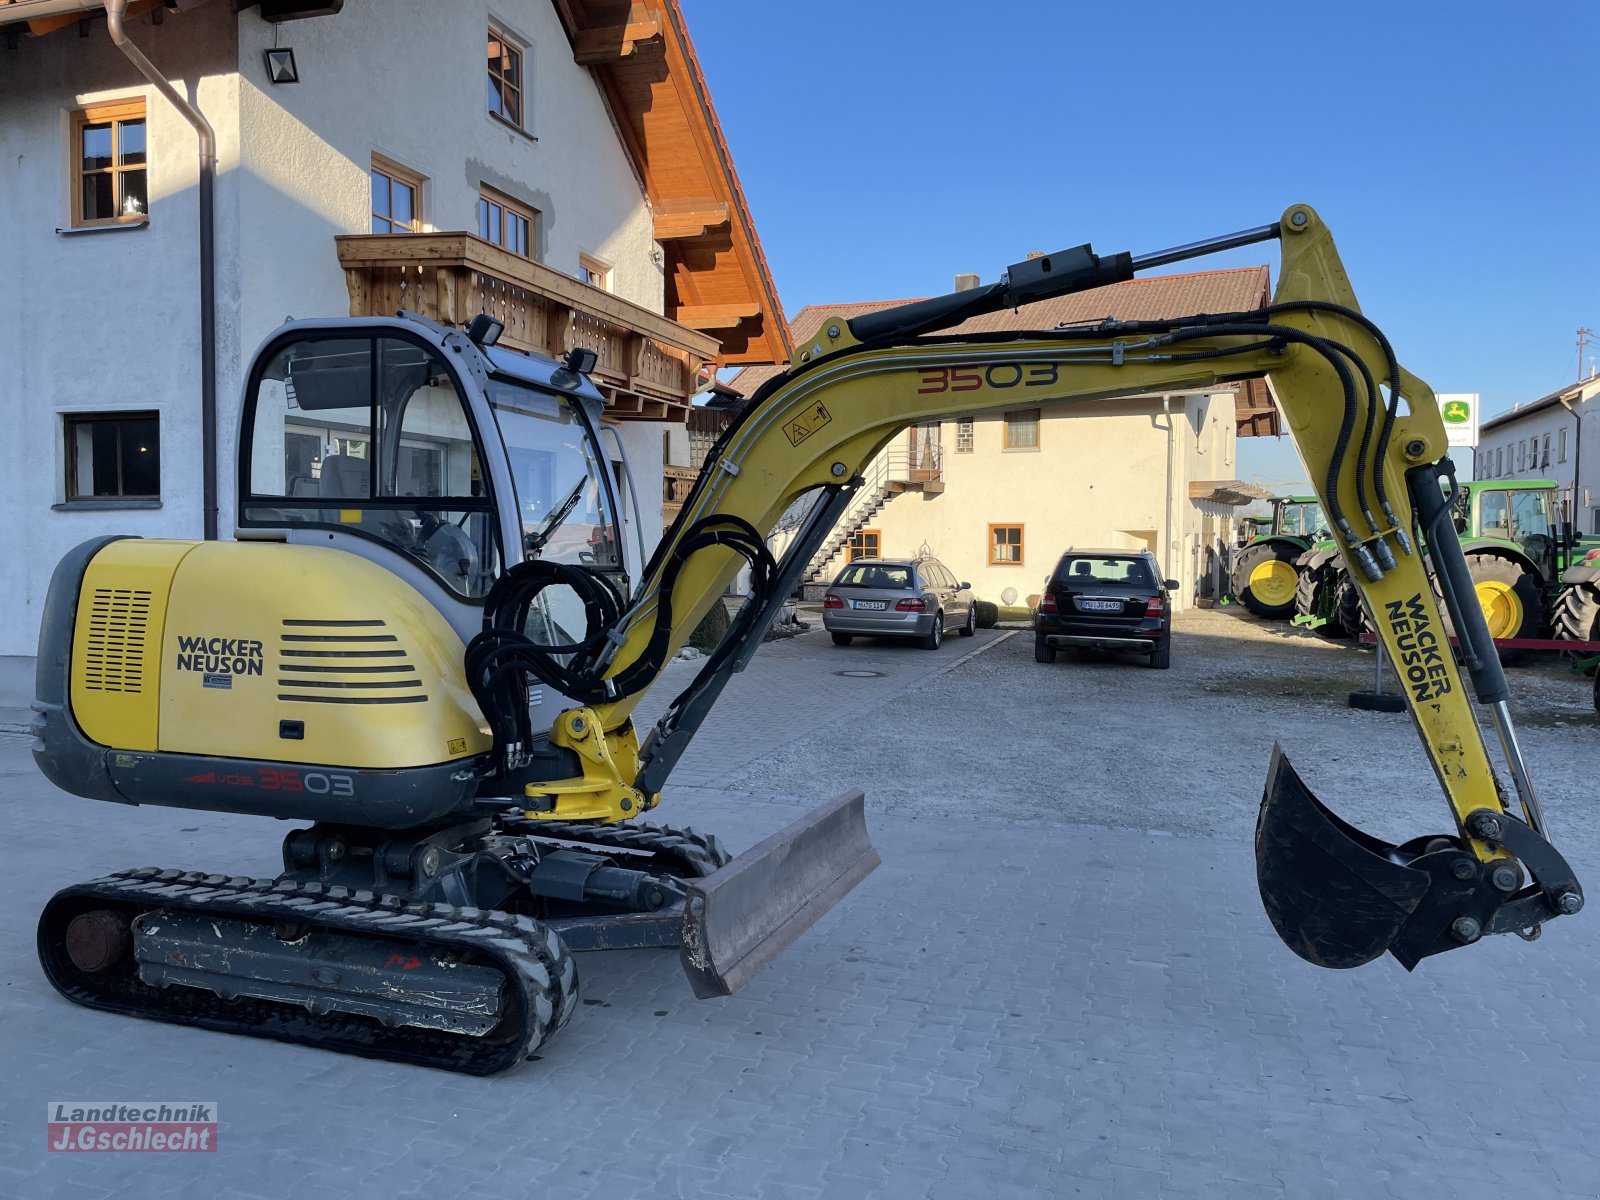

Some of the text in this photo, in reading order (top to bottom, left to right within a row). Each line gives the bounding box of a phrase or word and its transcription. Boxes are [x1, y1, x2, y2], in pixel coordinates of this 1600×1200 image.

[917, 363, 1059, 395] 3503
[178, 635, 264, 658] WACKER
[1385, 600, 1434, 702] NEUSON
[1406, 593, 1452, 698] WACKER
[177, 653, 264, 676] NEUSON
[257, 768, 355, 797] 3503
